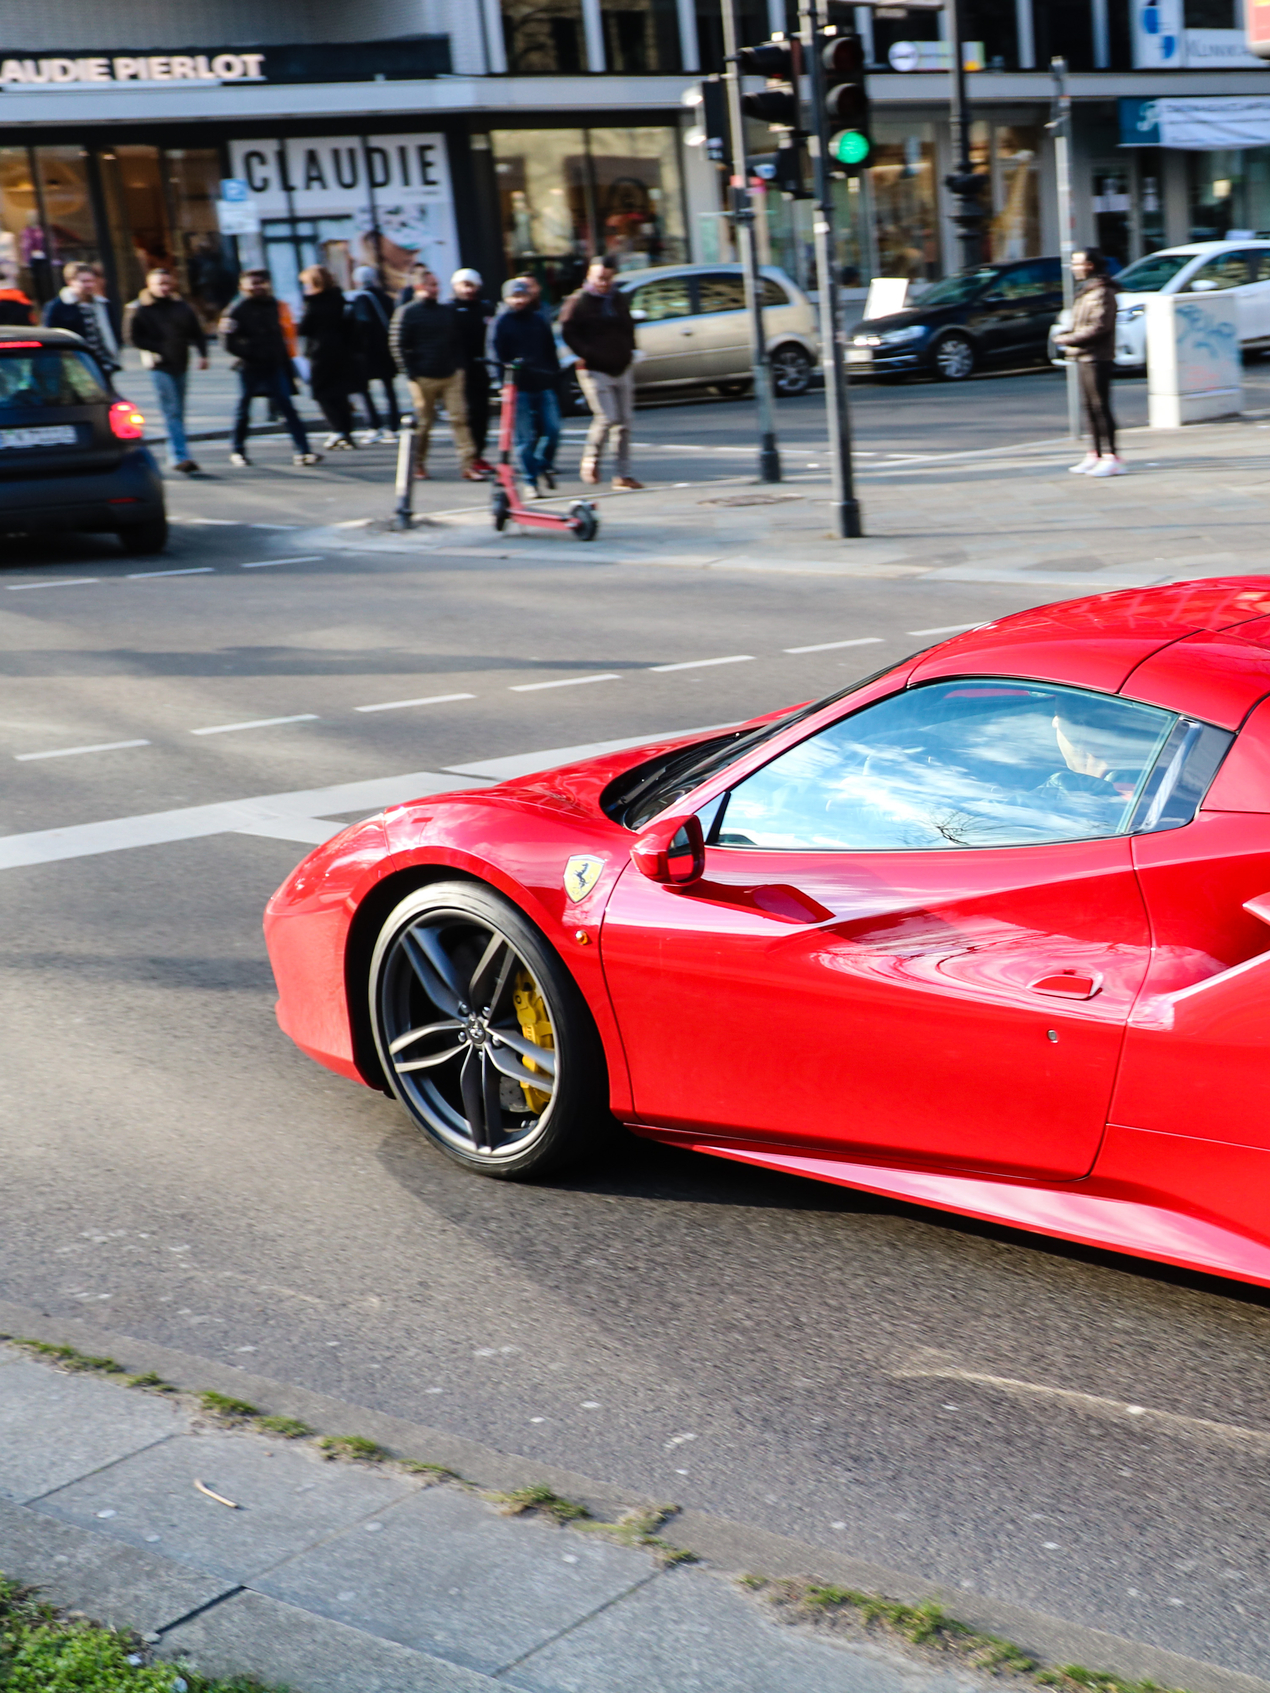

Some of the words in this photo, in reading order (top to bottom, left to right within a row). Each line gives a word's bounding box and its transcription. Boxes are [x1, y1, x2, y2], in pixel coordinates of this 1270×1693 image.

[0, 57, 112, 84] AUDIE
[113, 54, 266, 82] PIERLOT
[244, 144, 439, 193] CLAUDIE
